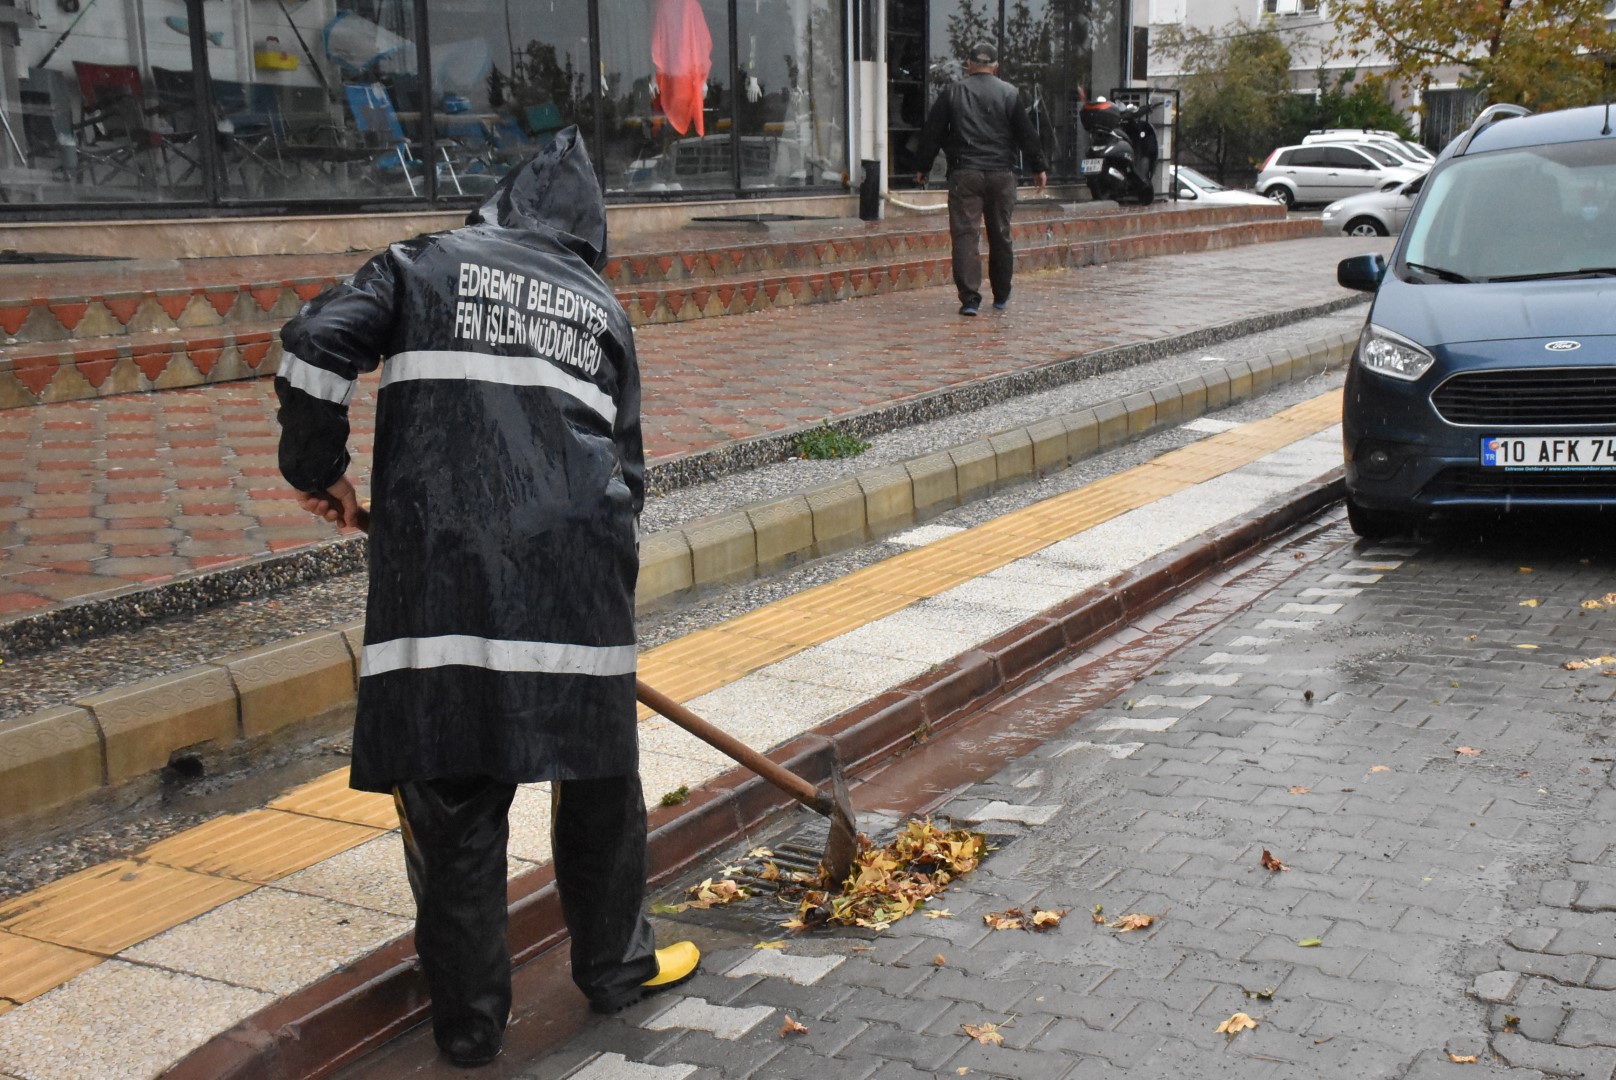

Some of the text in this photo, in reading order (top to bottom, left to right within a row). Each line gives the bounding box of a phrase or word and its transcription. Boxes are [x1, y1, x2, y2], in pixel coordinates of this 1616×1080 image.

[454, 301, 483, 341] FEN
[1485, 453, 1495, 461] TR
[1500, 439, 1616, 462] 10 AFK 74
